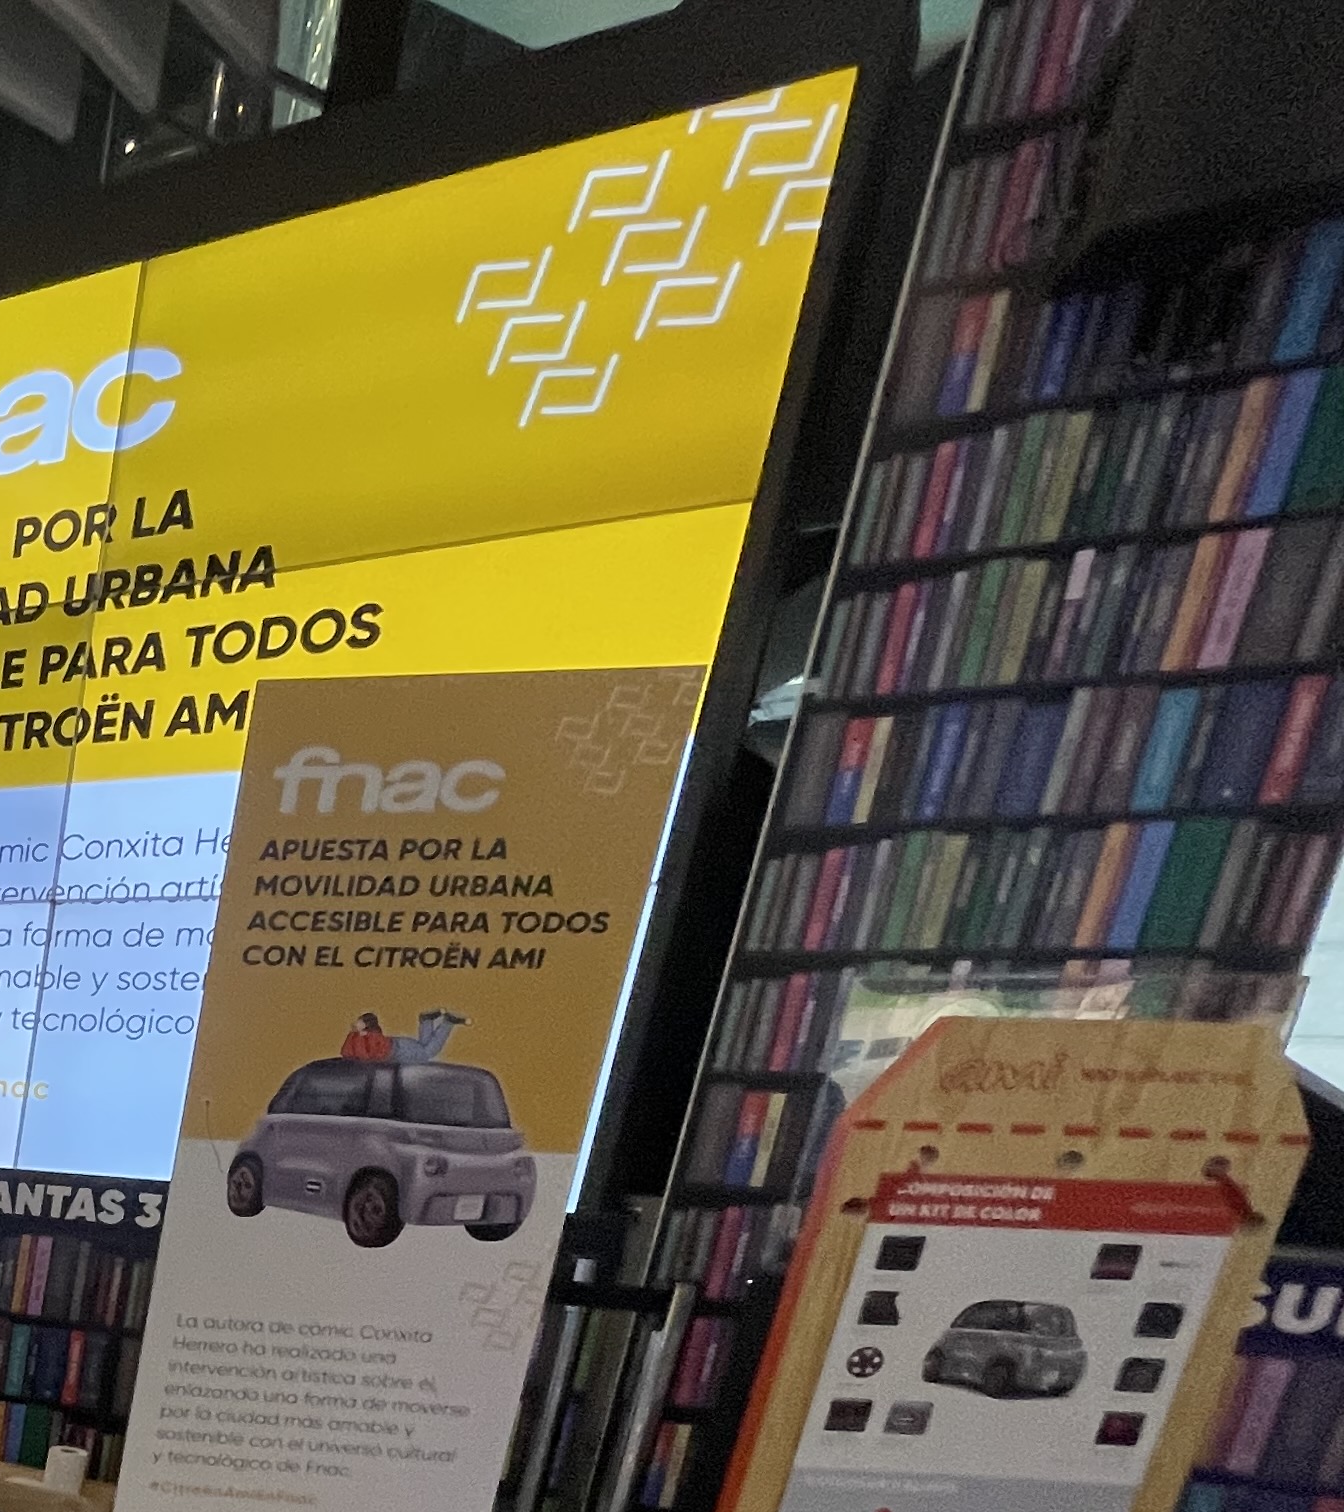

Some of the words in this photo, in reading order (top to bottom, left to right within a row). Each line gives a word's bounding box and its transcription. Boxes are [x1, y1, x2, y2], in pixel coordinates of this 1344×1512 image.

[12, 503, 118, 559] POR
[131, 489, 193, 539] LA
[63, 545, 276, 618] URBANA
[39, 632, 167, 685] PARA
[186, 601, 383, 669] TODOS
[164, 689, 250, 738] AM
[273, 744, 506, 816] fnac
[62, 831, 184, 861] Conxita
[258, 838, 389, 862] APUESTA
[398, 838, 460, 862] POR
[471, 837, 508, 862] LA
[161, 873, 220, 903] artí
[254, 874, 420, 898] MOVILIDAD
[428, 875, 554, 898] URBANA
[23, 921, 113, 948] forma
[123, 922, 165, 948] de
[247, 910, 403, 934] ACCESIBLE
[412, 911, 490, 935] PARA
[501, 911, 611, 935] TODOS
[242, 944, 307, 968] CON
[315, 945, 345, 968] EL
[354, 942, 480, 969] CITROËN
[487, 946, 546, 970] AMI
[90, 972, 109, 996] y
[116, 967, 204, 991] soste
[12, 1007, 195, 1040] tecnológico
[135, 1192, 164, 1229] 3
[176, 1313, 198, 1329] La
[203, 1316, 264, 1333] autora
[269, 1319, 295, 1334] de
[243, 1340, 266, 1356] ha
[272, 1344, 356, 1362] realizado
[362, 1351, 397, 1365] una
[164, 1383, 259, 1401] enlazando
[264, 1391, 298, 1405] una
[305, 1391, 357, 1409] forma
[362, 1397, 387, 1411] de
[391, 1400, 470, 1418] moverse
[160, 1406, 190, 1419] por
[195, 1406, 212, 1421] la
[216, 1409, 280, 1426] ciudad
[327, 1419, 399, 1435] amable
[156, 1428, 244, 1446] sostenible
[249, 1436, 283, 1449] con
[288, 1437, 304, 1450] el
[386, 1446, 456, 1463] cultural
[152, 1452, 161, 1464] y
[168, 1451, 272, 1472] tecnológico
[276, 1459, 300, 1473] de
